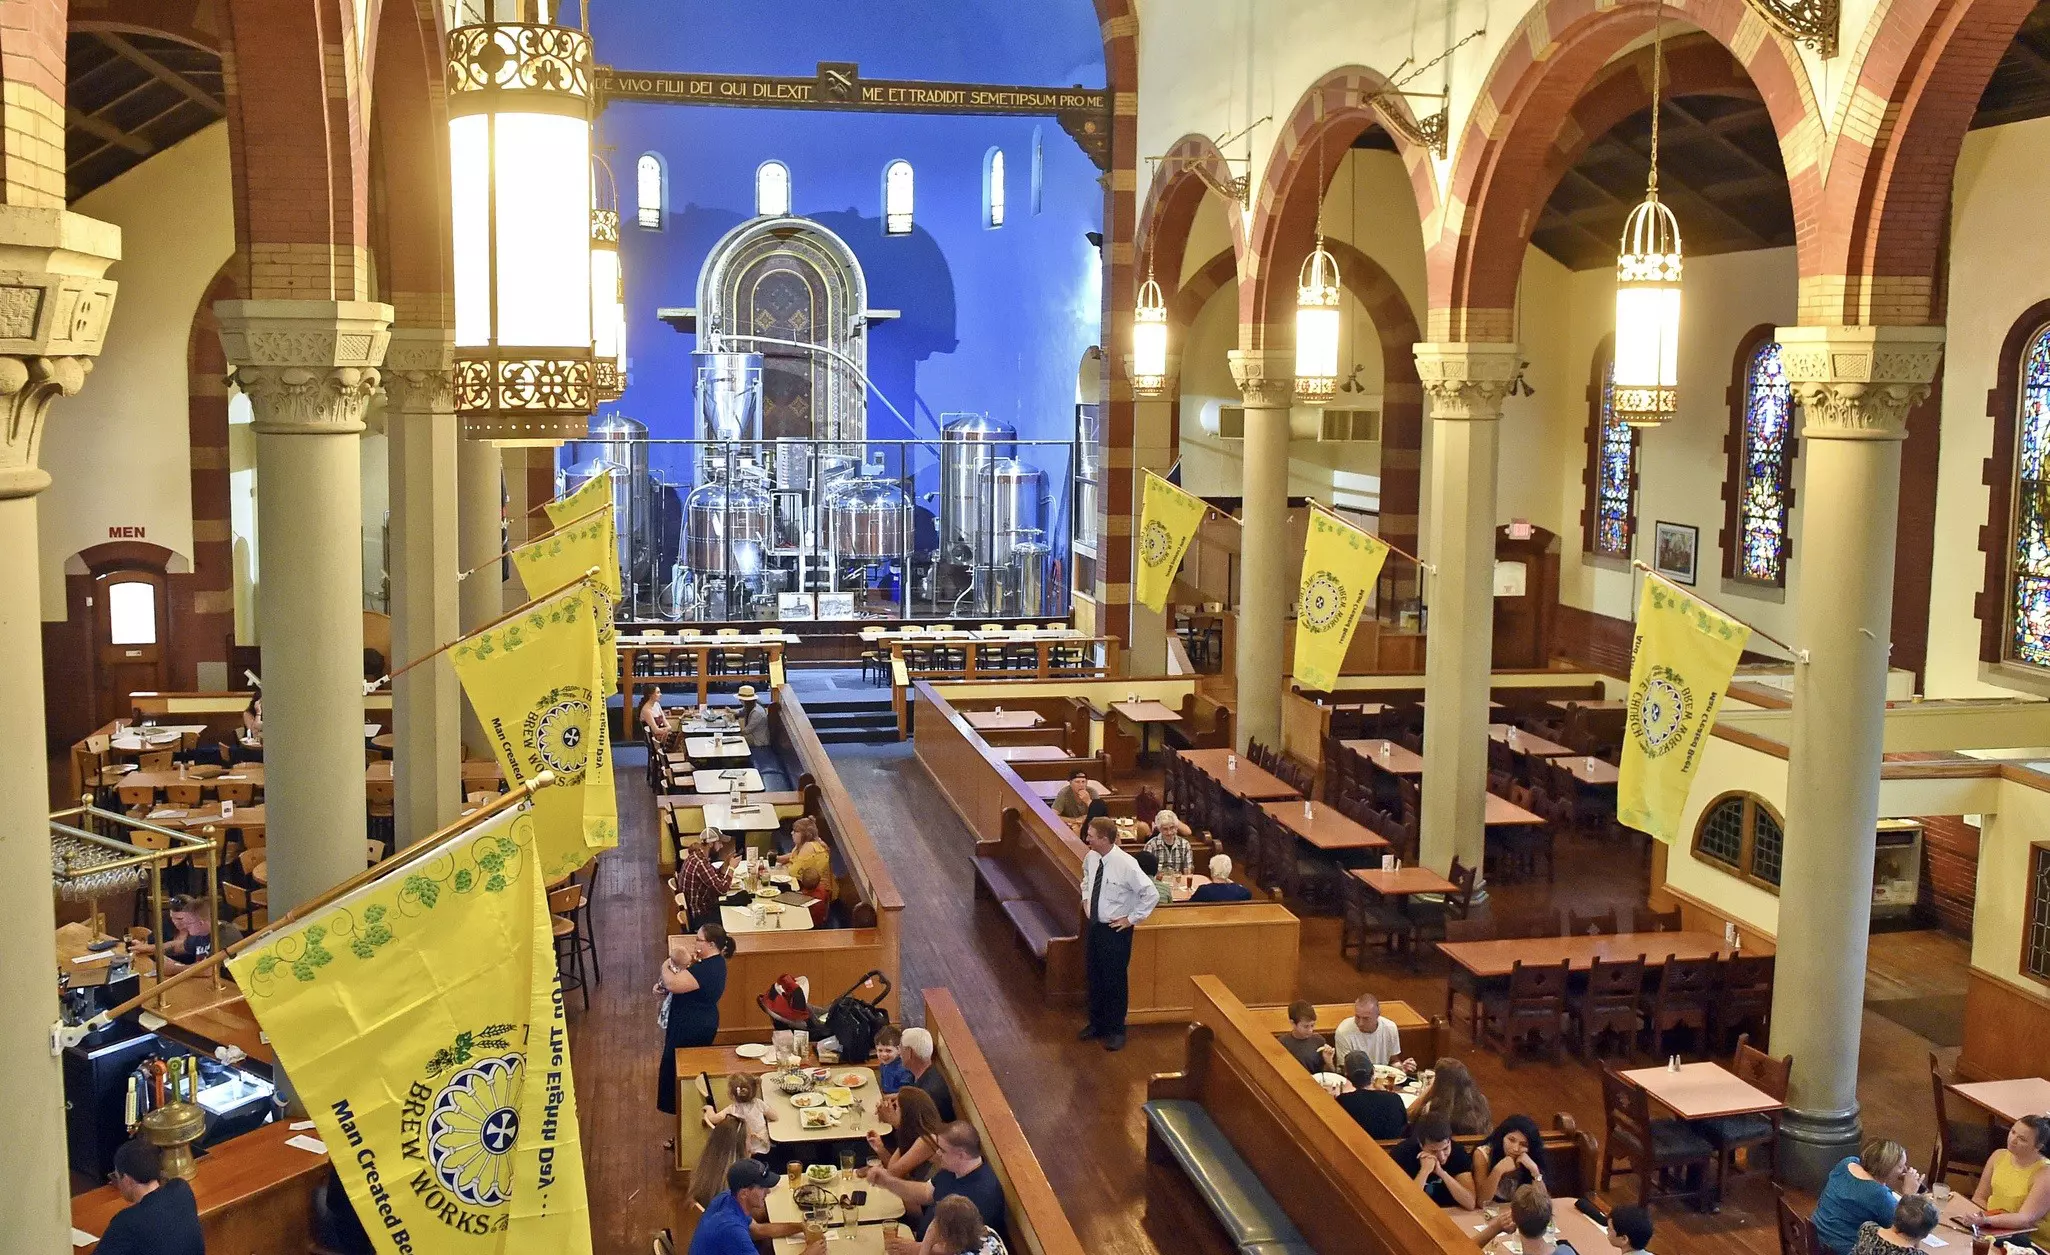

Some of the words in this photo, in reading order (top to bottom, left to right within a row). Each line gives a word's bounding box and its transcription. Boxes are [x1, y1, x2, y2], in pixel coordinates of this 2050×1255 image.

[619, 78, 652, 92] VIVO
[656, 80, 684, 93] FILII
[690, 81, 712, 95] DEI
[720, 82, 746, 96] QUI
[753, 83, 812, 100] DILEXIT
[862, 87, 884, 101] ME
[888, 88, 907, 102] ET
[908, 89, 967, 104] TRADIDIT
[970, 91, 1057, 106] SEMETIPSUM
[1060, 95, 1085, 106] PRO
[1087, 96, 1104, 107] ME
[109, 527, 145, 538] MEN
[491, 717, 506, 741] Man
[502, 741, 524, 781] Created
[522, 711, 539, 749] BREW
[528, 753, 566, 787] WOS
[401, 1080, 433, 1162] BREW
[331, 1099, 364, 1148] Man
[356, 1148, 403, 1229] Created
[391, 1228, 414, 1255] Be
[409, 1169, 490, 1235] WORKS
